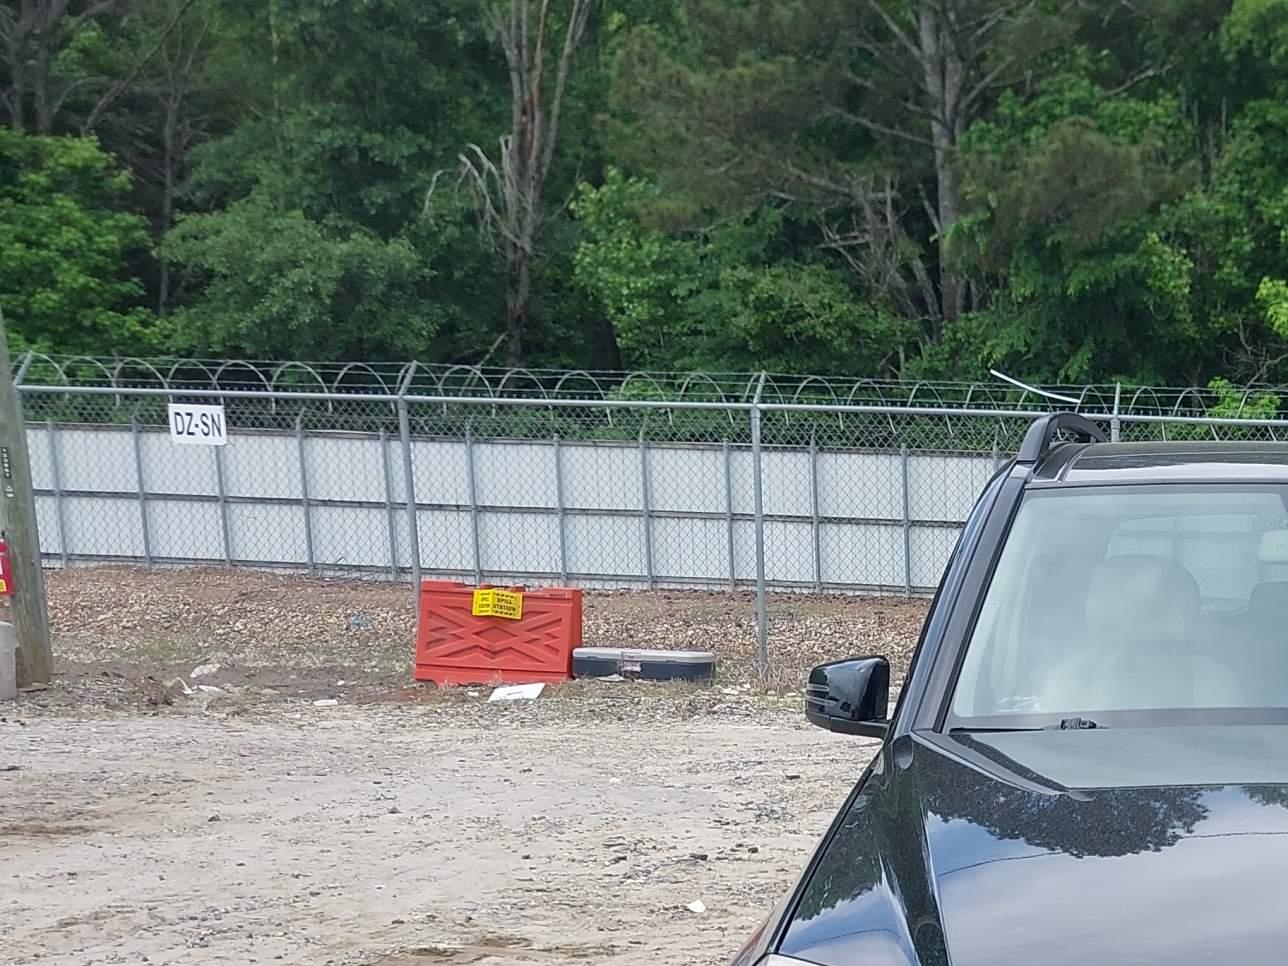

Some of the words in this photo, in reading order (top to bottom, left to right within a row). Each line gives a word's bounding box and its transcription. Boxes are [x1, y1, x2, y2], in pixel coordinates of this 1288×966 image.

[174, 411, 222, 437] DZ-SN
[496, 597, 513, 605] SPILL
[492, 603, 516, 612] STATION
